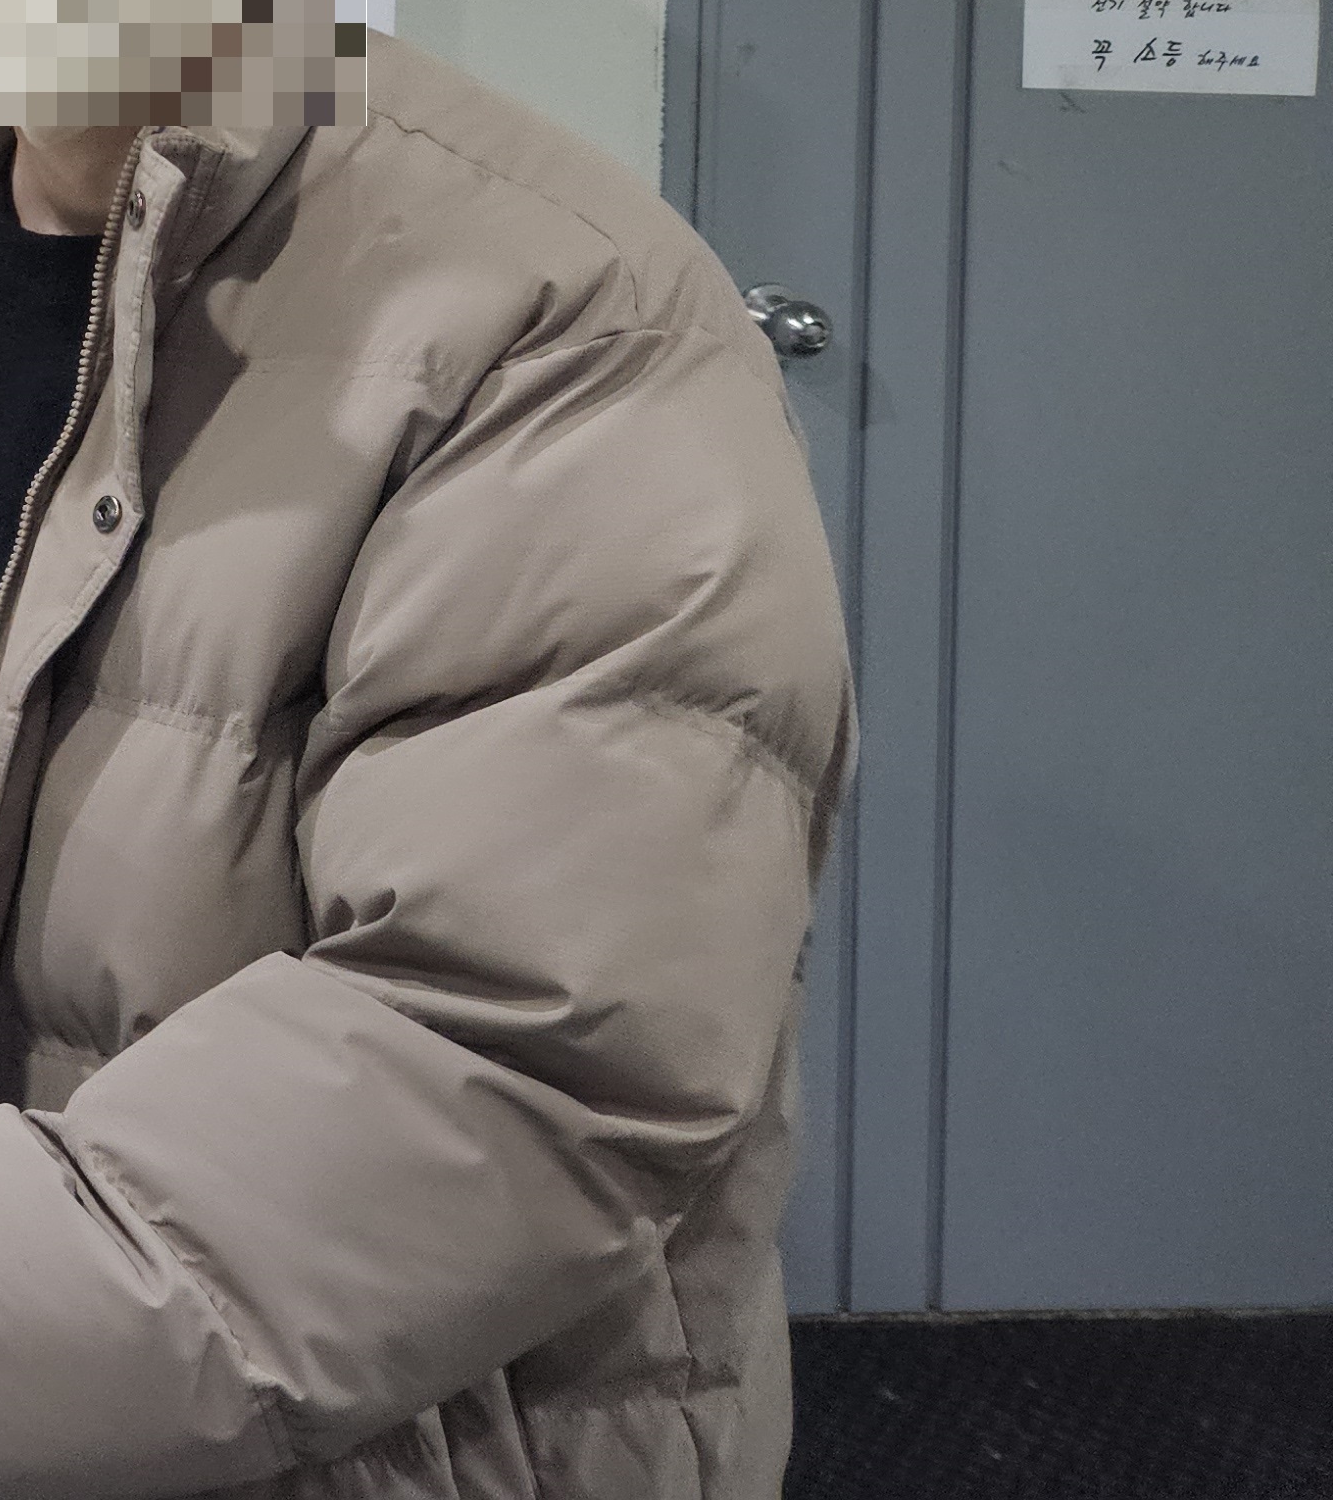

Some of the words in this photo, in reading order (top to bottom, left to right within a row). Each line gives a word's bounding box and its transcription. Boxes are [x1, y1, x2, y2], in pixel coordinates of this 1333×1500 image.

[1091, 39, 1113, 72] 꼭
[1133, 37, 1183, 67] 소등
[1197, 49, 1261, 73] 해주세요
